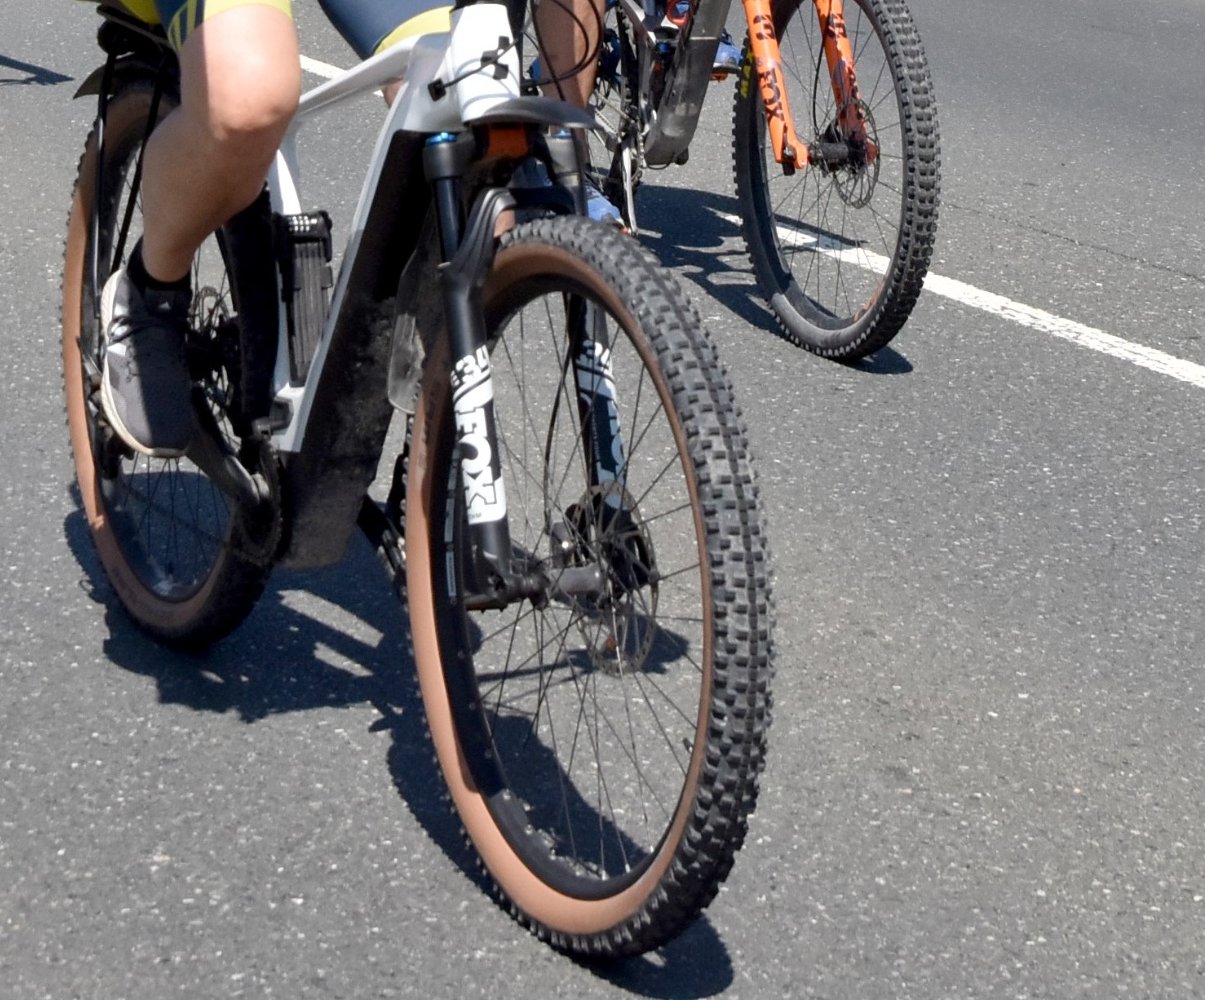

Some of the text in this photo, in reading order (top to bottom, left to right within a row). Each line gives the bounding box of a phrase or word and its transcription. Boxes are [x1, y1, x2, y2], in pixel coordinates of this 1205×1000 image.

[740, 50, 755, 99] MAX
[758, 67, 786, 122] FOX
[455, 406, 498, 509] FOX
